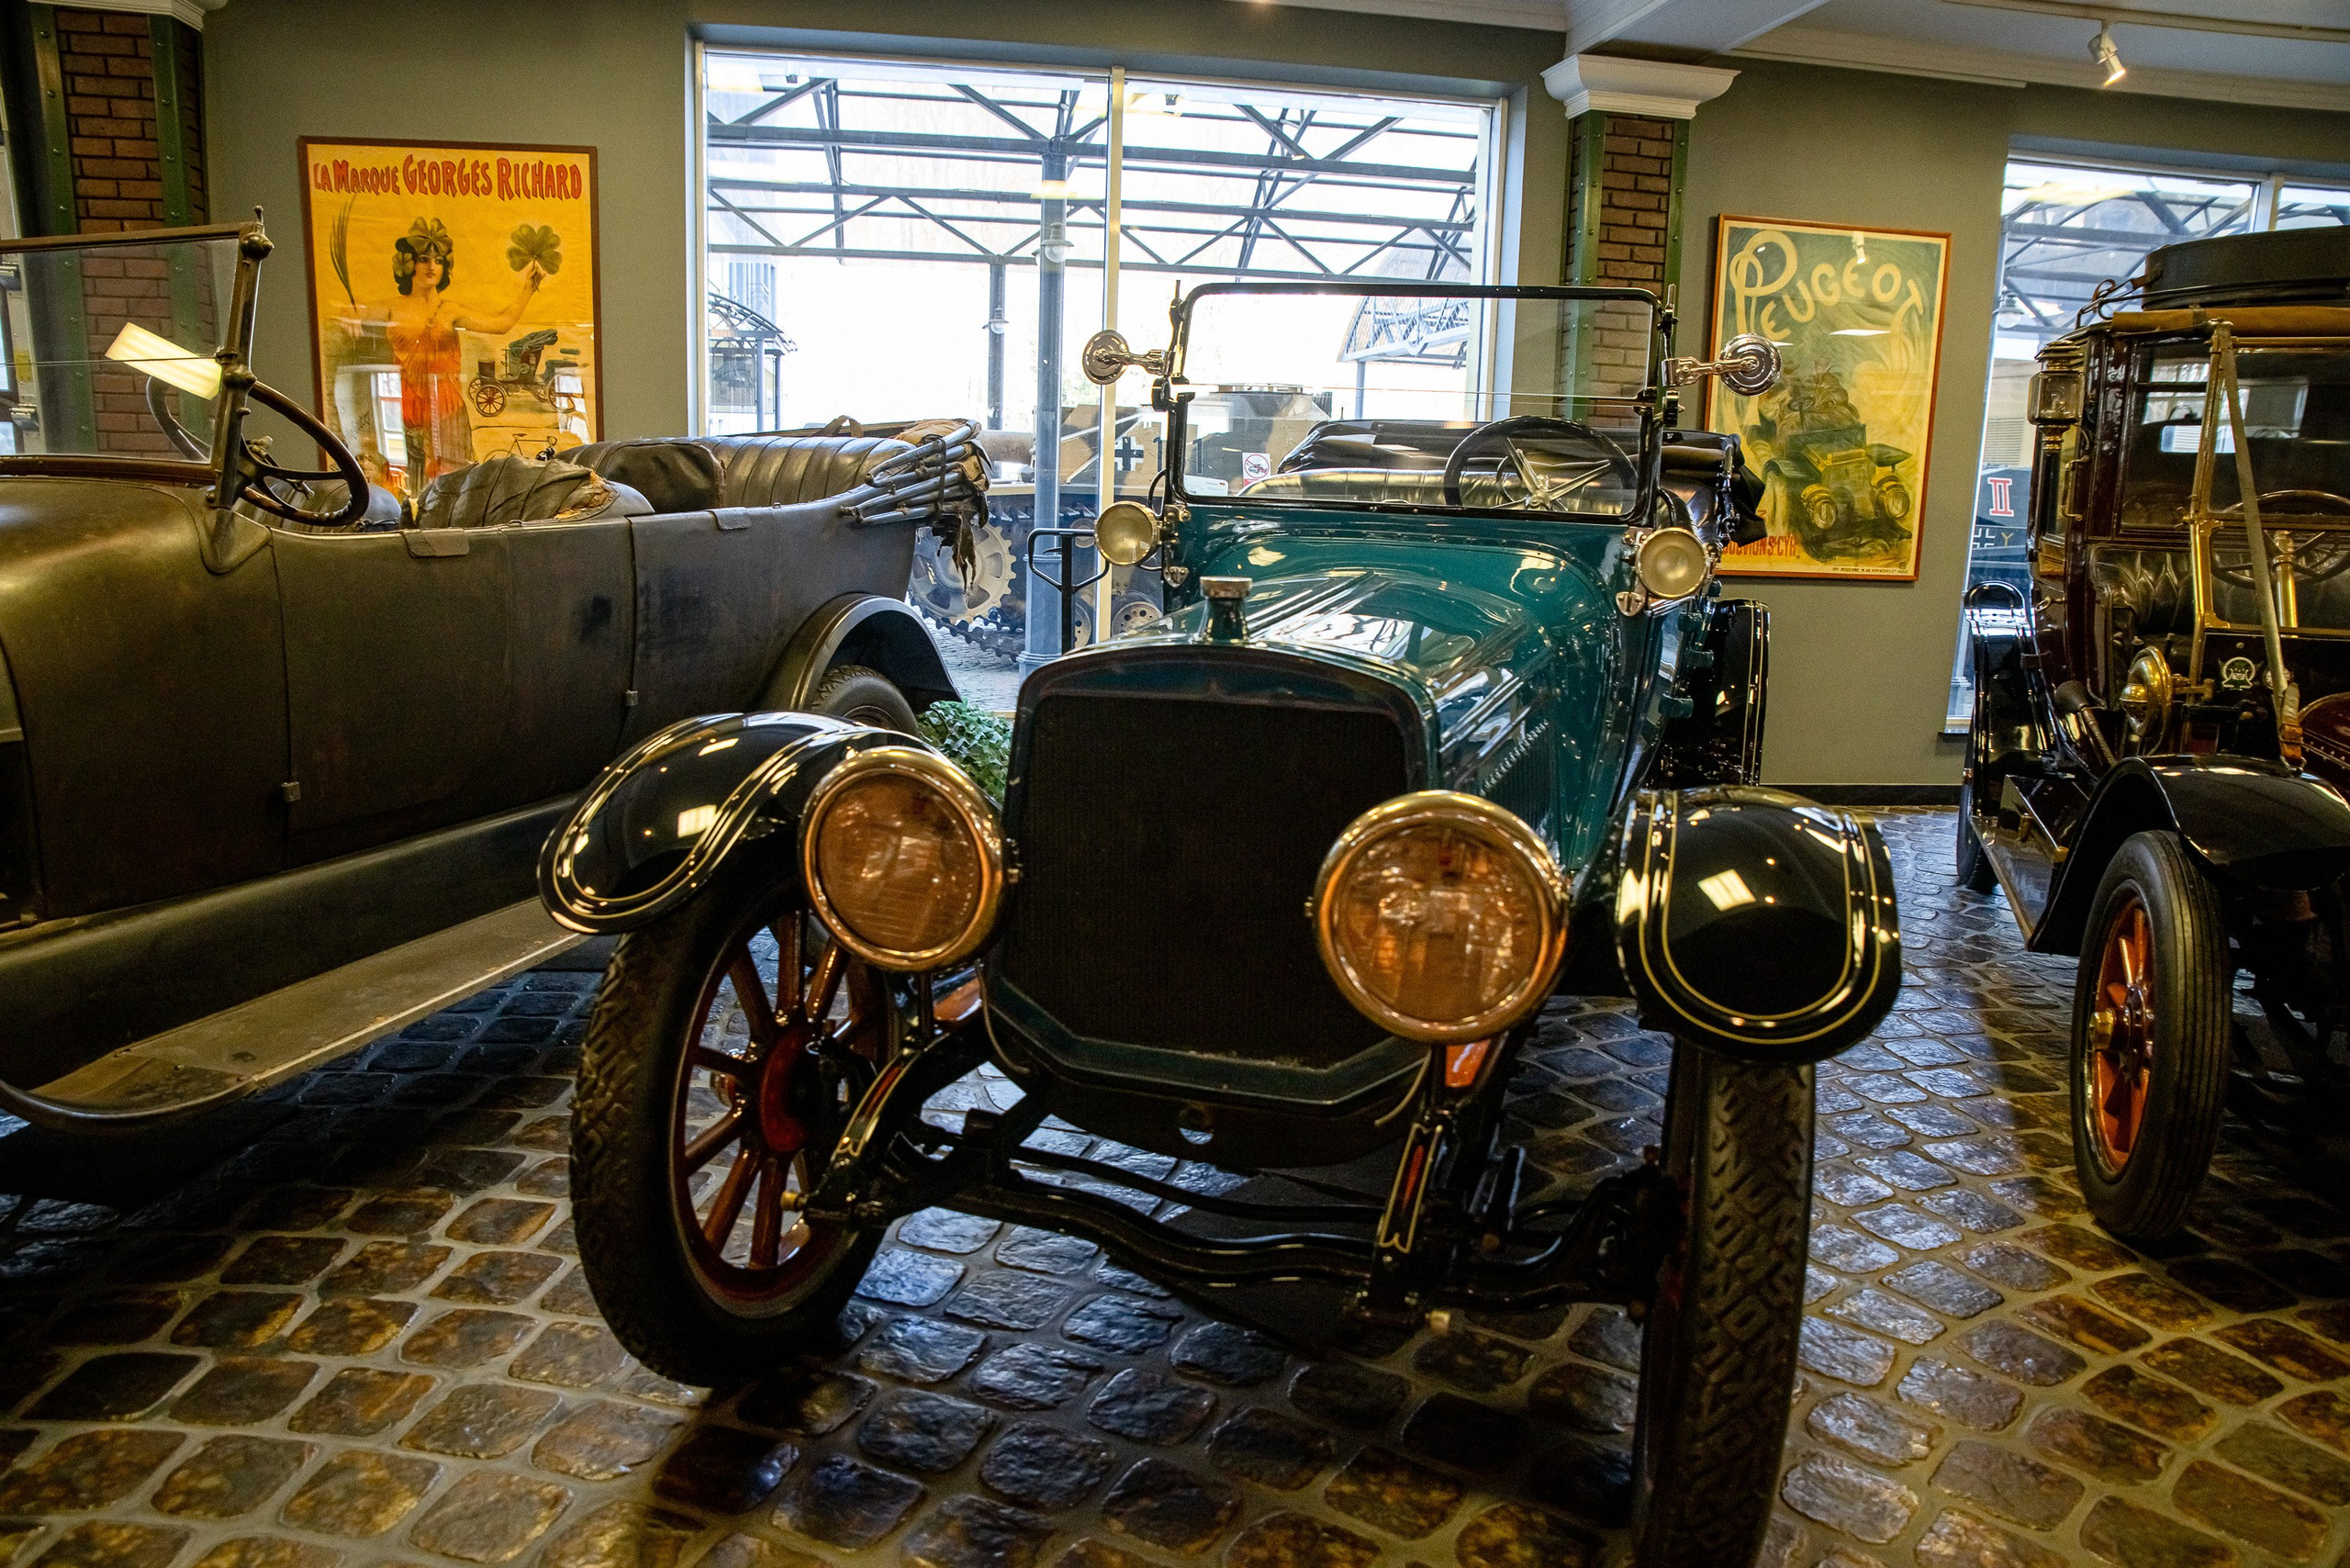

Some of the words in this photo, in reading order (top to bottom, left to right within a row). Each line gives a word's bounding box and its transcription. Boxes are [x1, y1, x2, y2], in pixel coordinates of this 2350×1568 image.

[312, 162, 333, 194] LA
[332, 159, 400, 196] MARQUE
[402, 153, 493, 198] GEORGES
[496, 157, 583, 202] RICHARD
[1729, 230, 1924, 341] PEUGEOT
